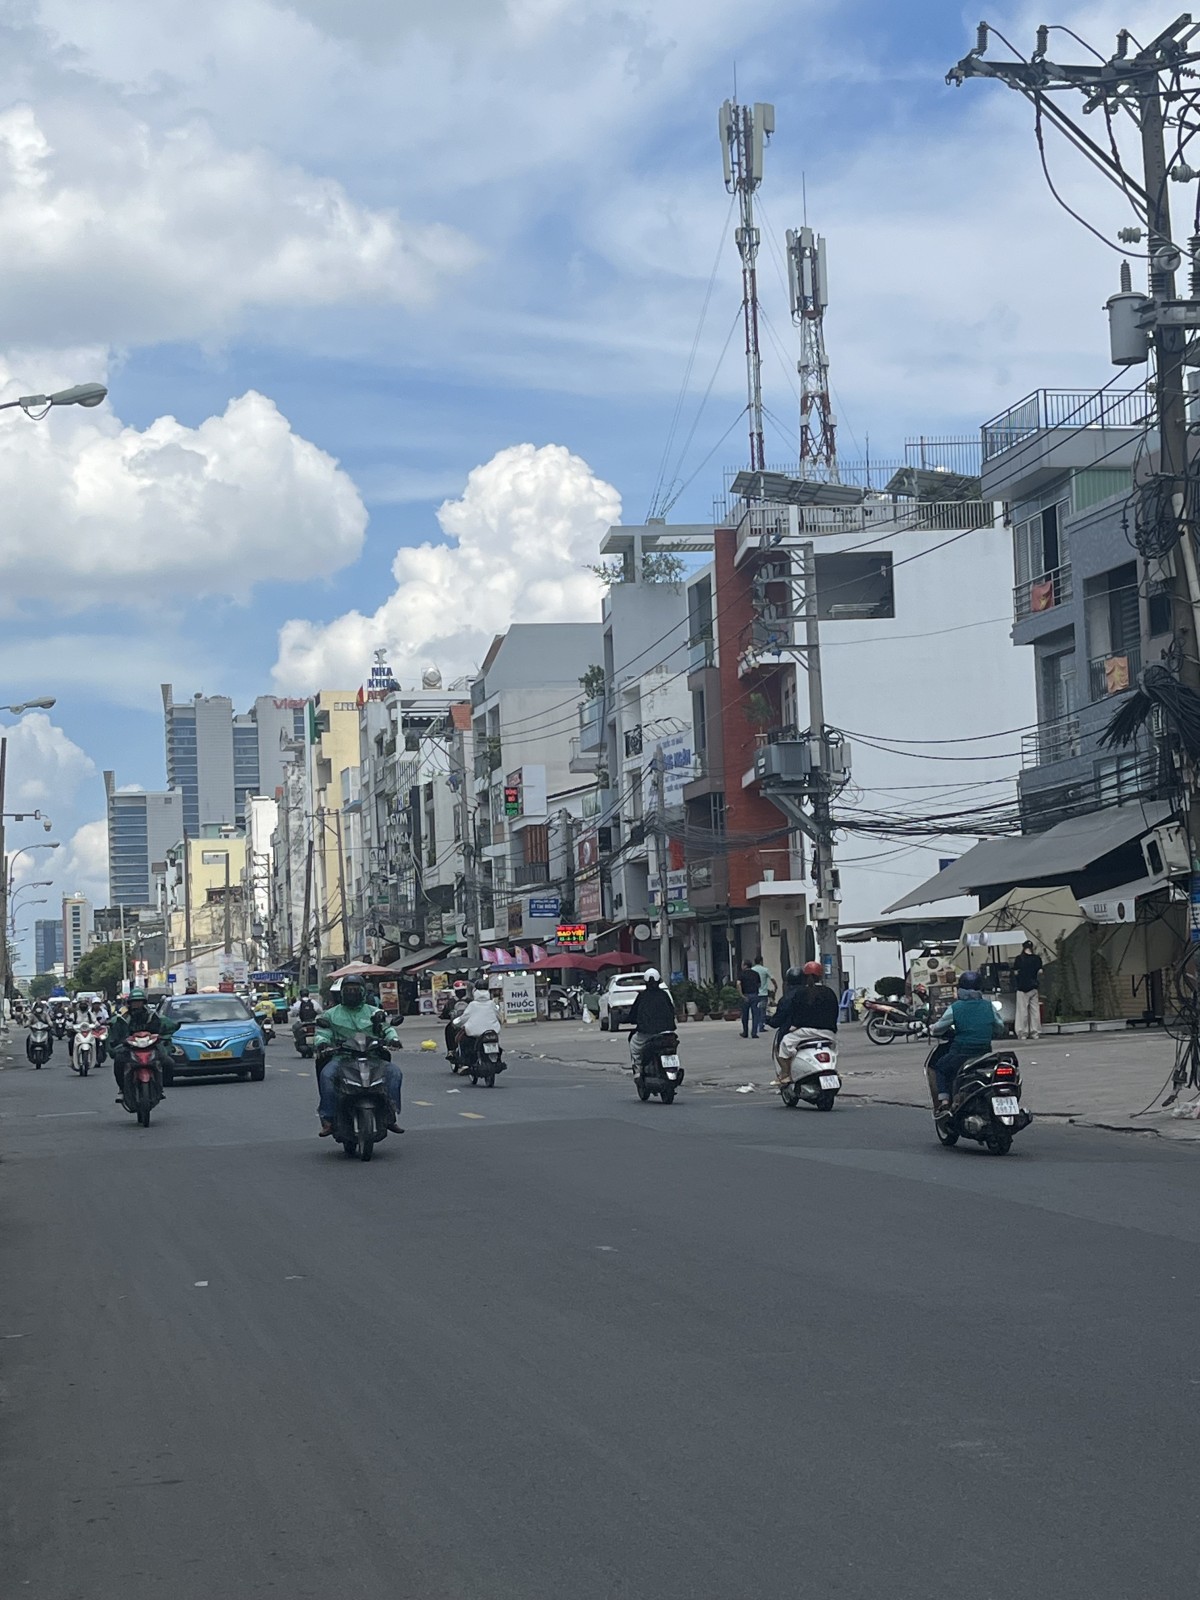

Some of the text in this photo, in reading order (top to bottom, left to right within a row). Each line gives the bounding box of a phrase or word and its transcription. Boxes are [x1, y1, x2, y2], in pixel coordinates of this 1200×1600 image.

[390, 813, 408, 825] GYM
[1093, 904, 1107, 913] ELLE
[511, 990, 529, 999] NHÀ
[506, 998, 535, 1009] THUỐC
